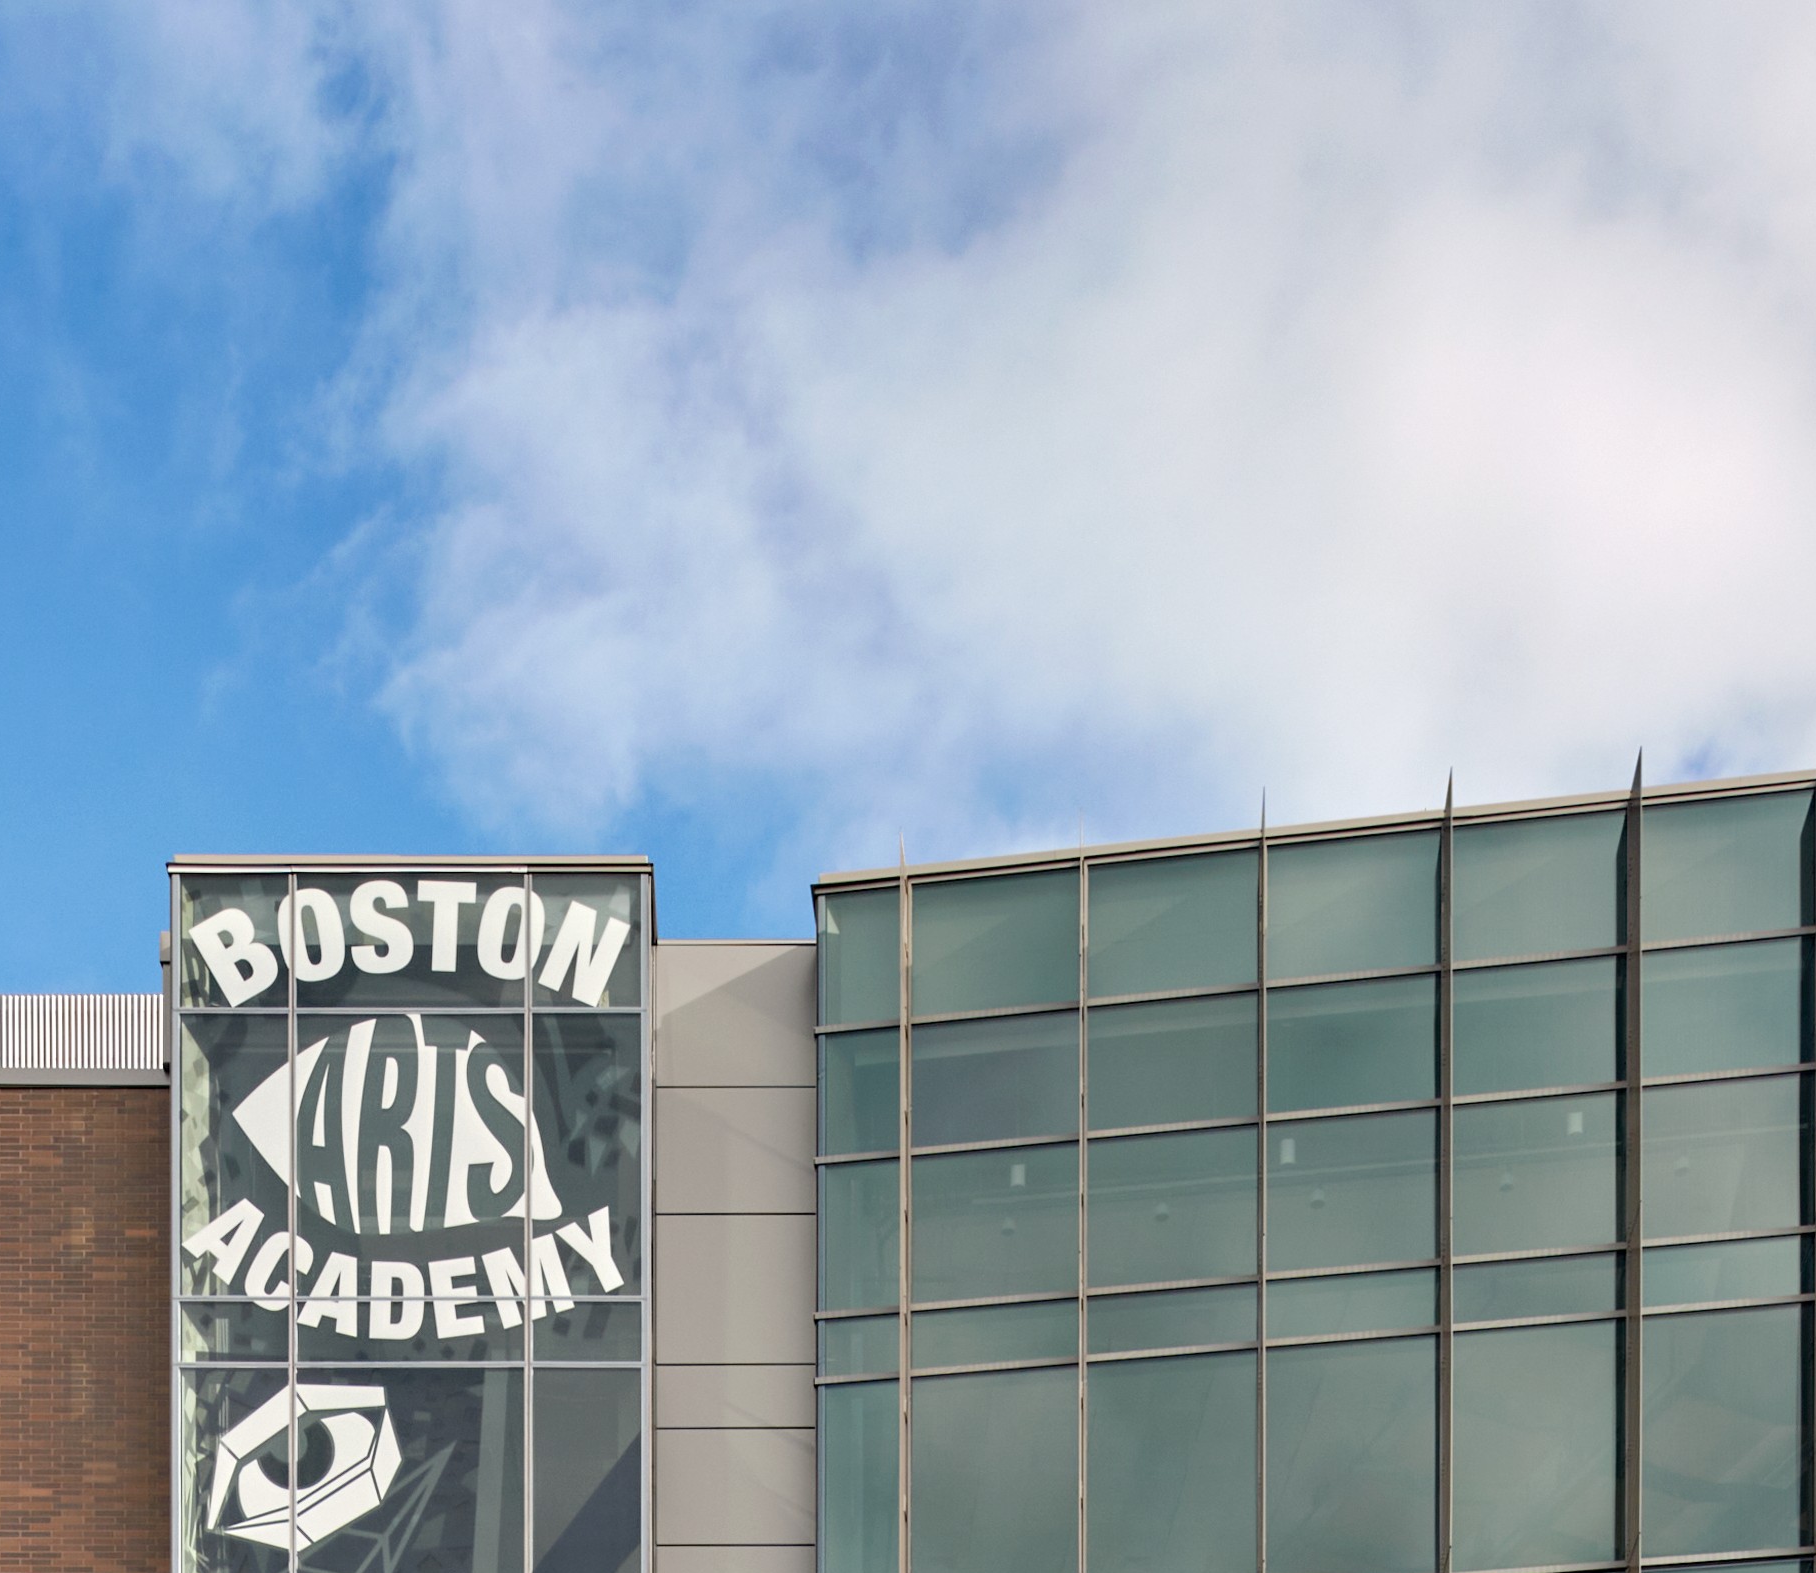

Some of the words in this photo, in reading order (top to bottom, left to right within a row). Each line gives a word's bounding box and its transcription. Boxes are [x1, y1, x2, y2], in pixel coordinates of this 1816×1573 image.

[188, 880, 631, 1008] BOSTON
[297, 1014, 532, 1236] ARTS
[182, 1198, 625, 1340] ACADEMY
